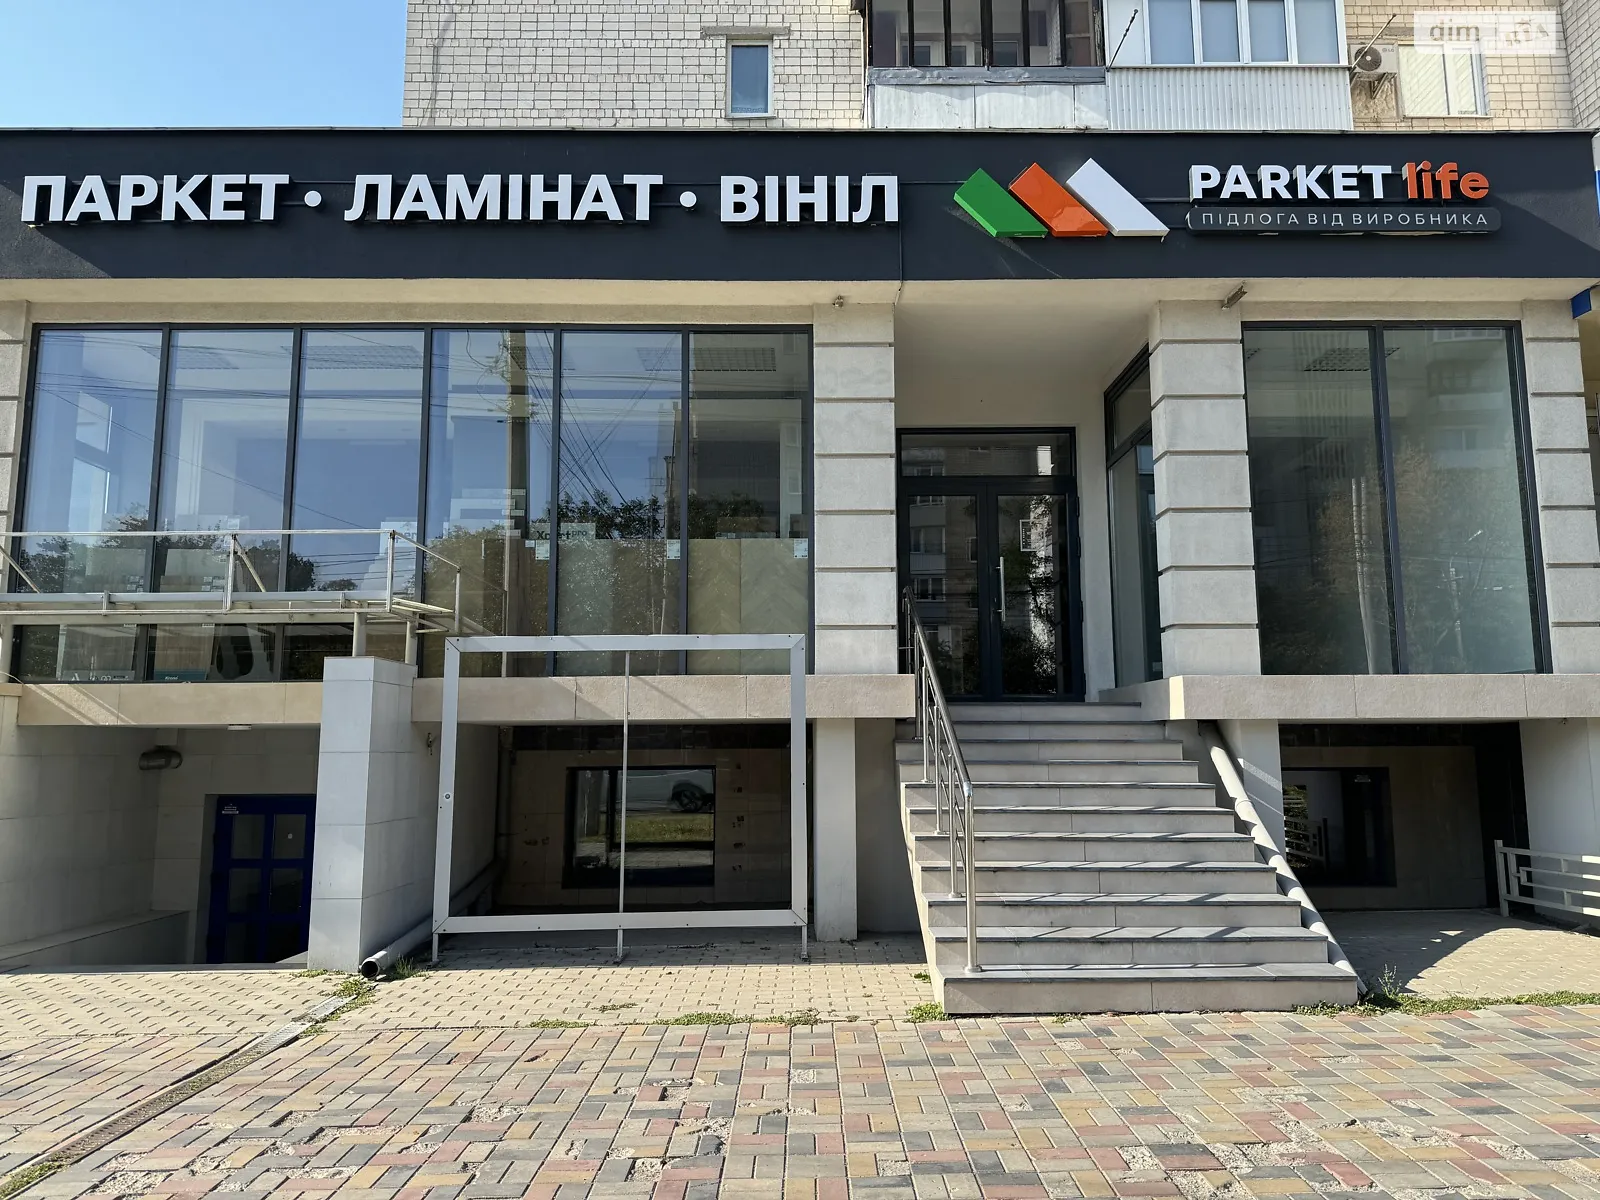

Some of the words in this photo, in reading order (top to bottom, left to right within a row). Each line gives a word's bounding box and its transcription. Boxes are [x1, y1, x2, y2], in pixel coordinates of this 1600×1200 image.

[20, 174, 290, 222] ПАРКЕТ
[343, 174, 664, 221] ЛАМІНАТ
[720, 174, 899, 223] ВІНІЛ
[1189, 164, 1392, 200] PARKET
[1403, 160, 1490, 200] life
[1201, 212, 1300, 227] ПІДЛОГА
[1307, 212, 1344, 227] ВІД
[1352, 212, 1488, 227] ВИРОБНИКА
